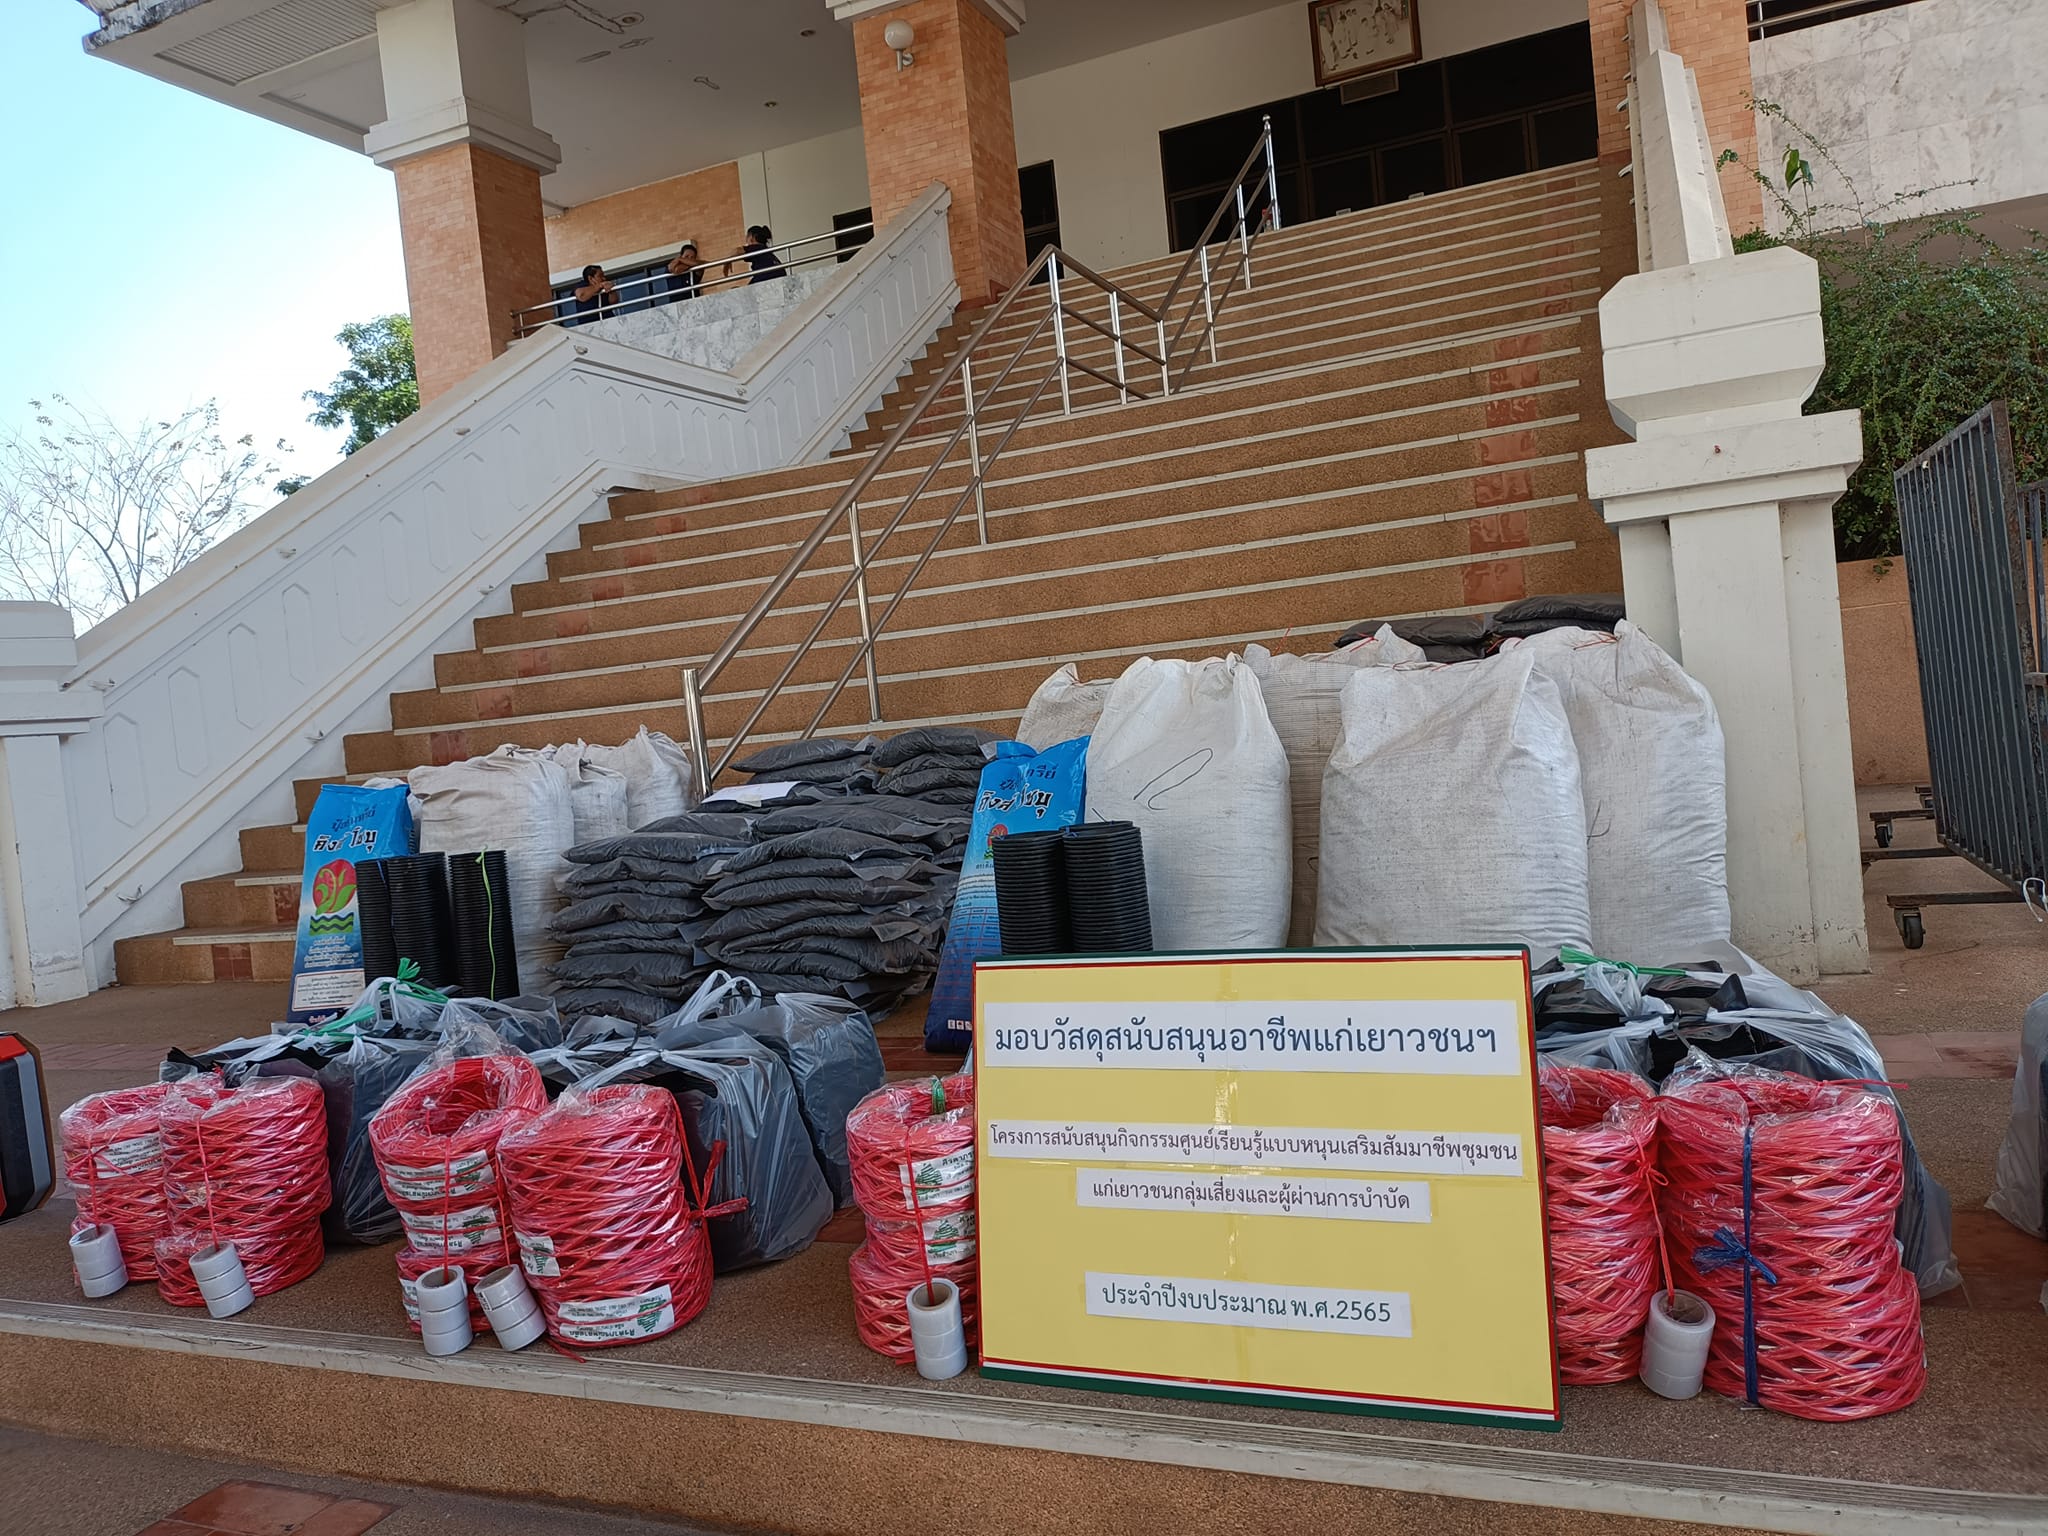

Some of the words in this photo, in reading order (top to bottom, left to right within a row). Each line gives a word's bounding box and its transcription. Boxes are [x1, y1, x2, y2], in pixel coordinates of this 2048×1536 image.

[995, 1015, 1497, 1063] มอบวัสดุสนับสนุนอาชีพแก่เยาวชนฯ
[990, 1124, 1518, 1166] โครงการสนับสนุนกิจกรรมศูนย์เรียนรู้แบบหนุนเสริมสัมมาชีพชุมชน
[1093, 1177, 1410, 1212] แก่เยาวชนกลุ่มเสี่ยงและผู้ผ่านการบำบัด
